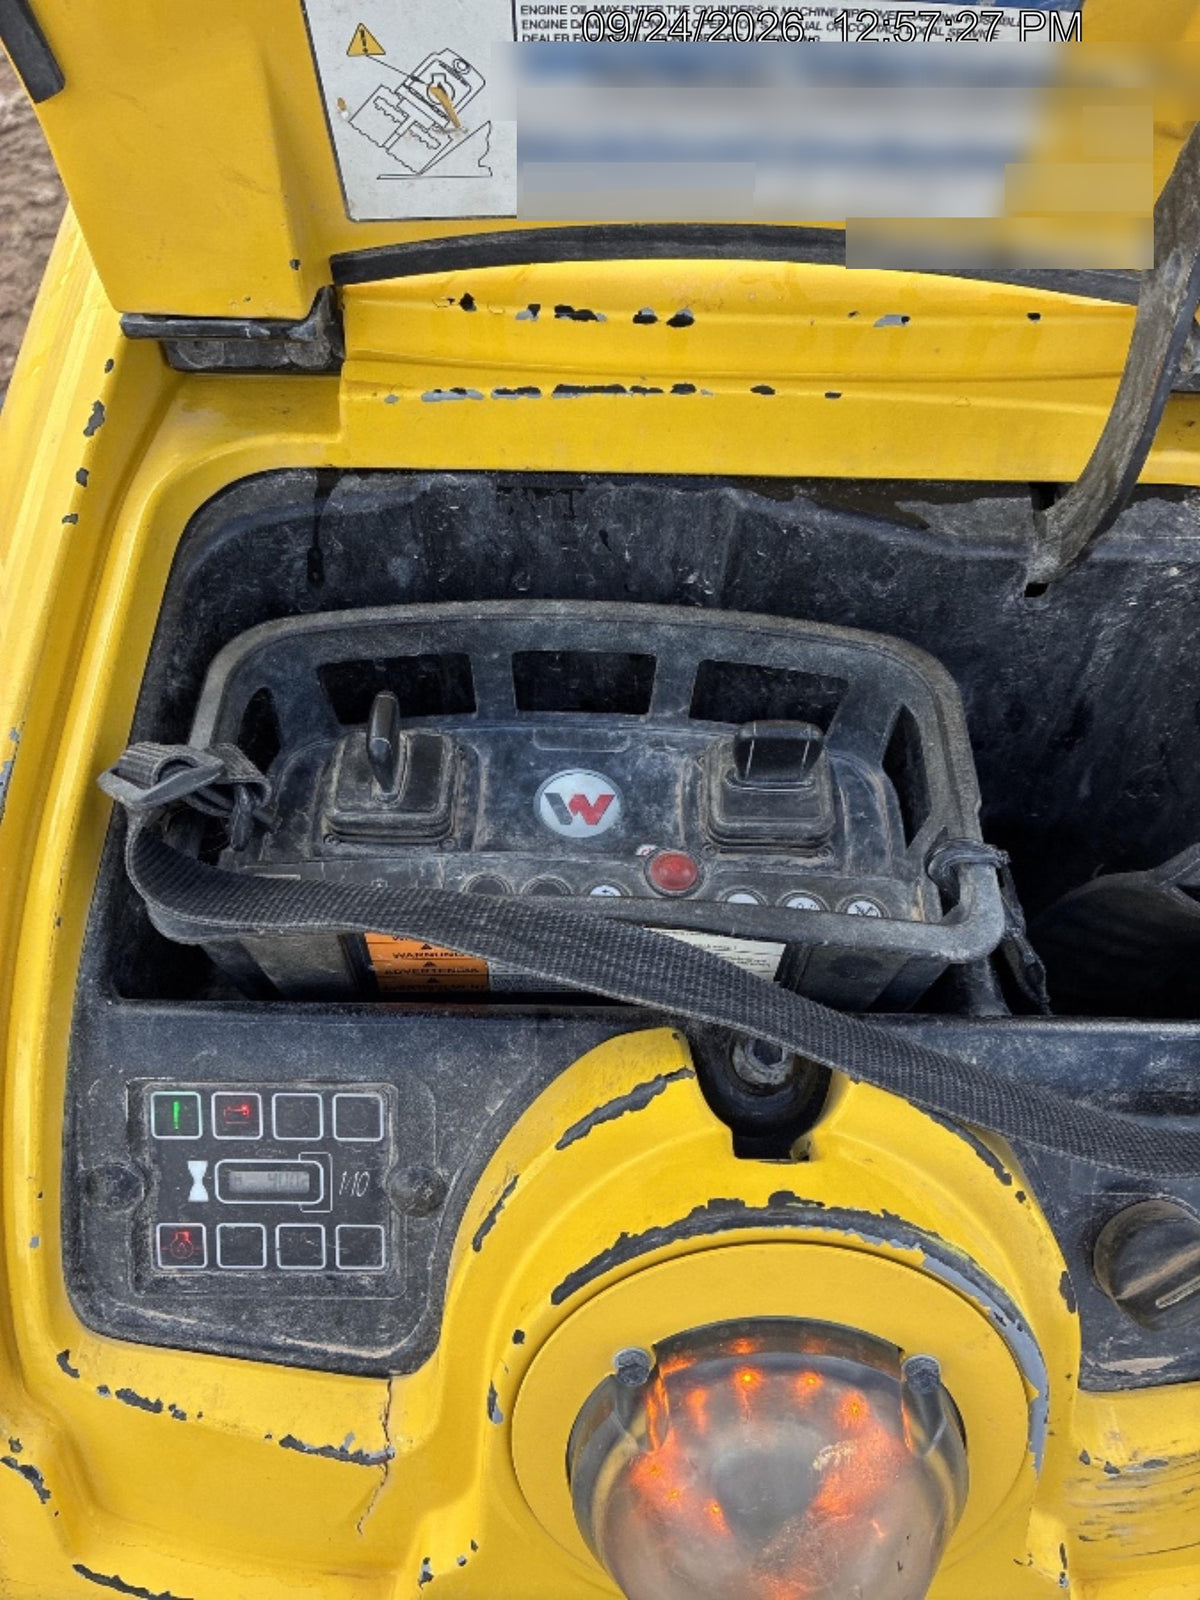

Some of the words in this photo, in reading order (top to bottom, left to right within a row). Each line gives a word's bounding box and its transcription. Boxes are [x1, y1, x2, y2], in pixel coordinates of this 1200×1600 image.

[520, 5, 568, 15] ENGINE
[570, 5, 587, 15] OIL
[666, 5, 690, 15] THE
[522, 19, 568, 29] ENGINE
[522, 34, 569, 42] DEALER
